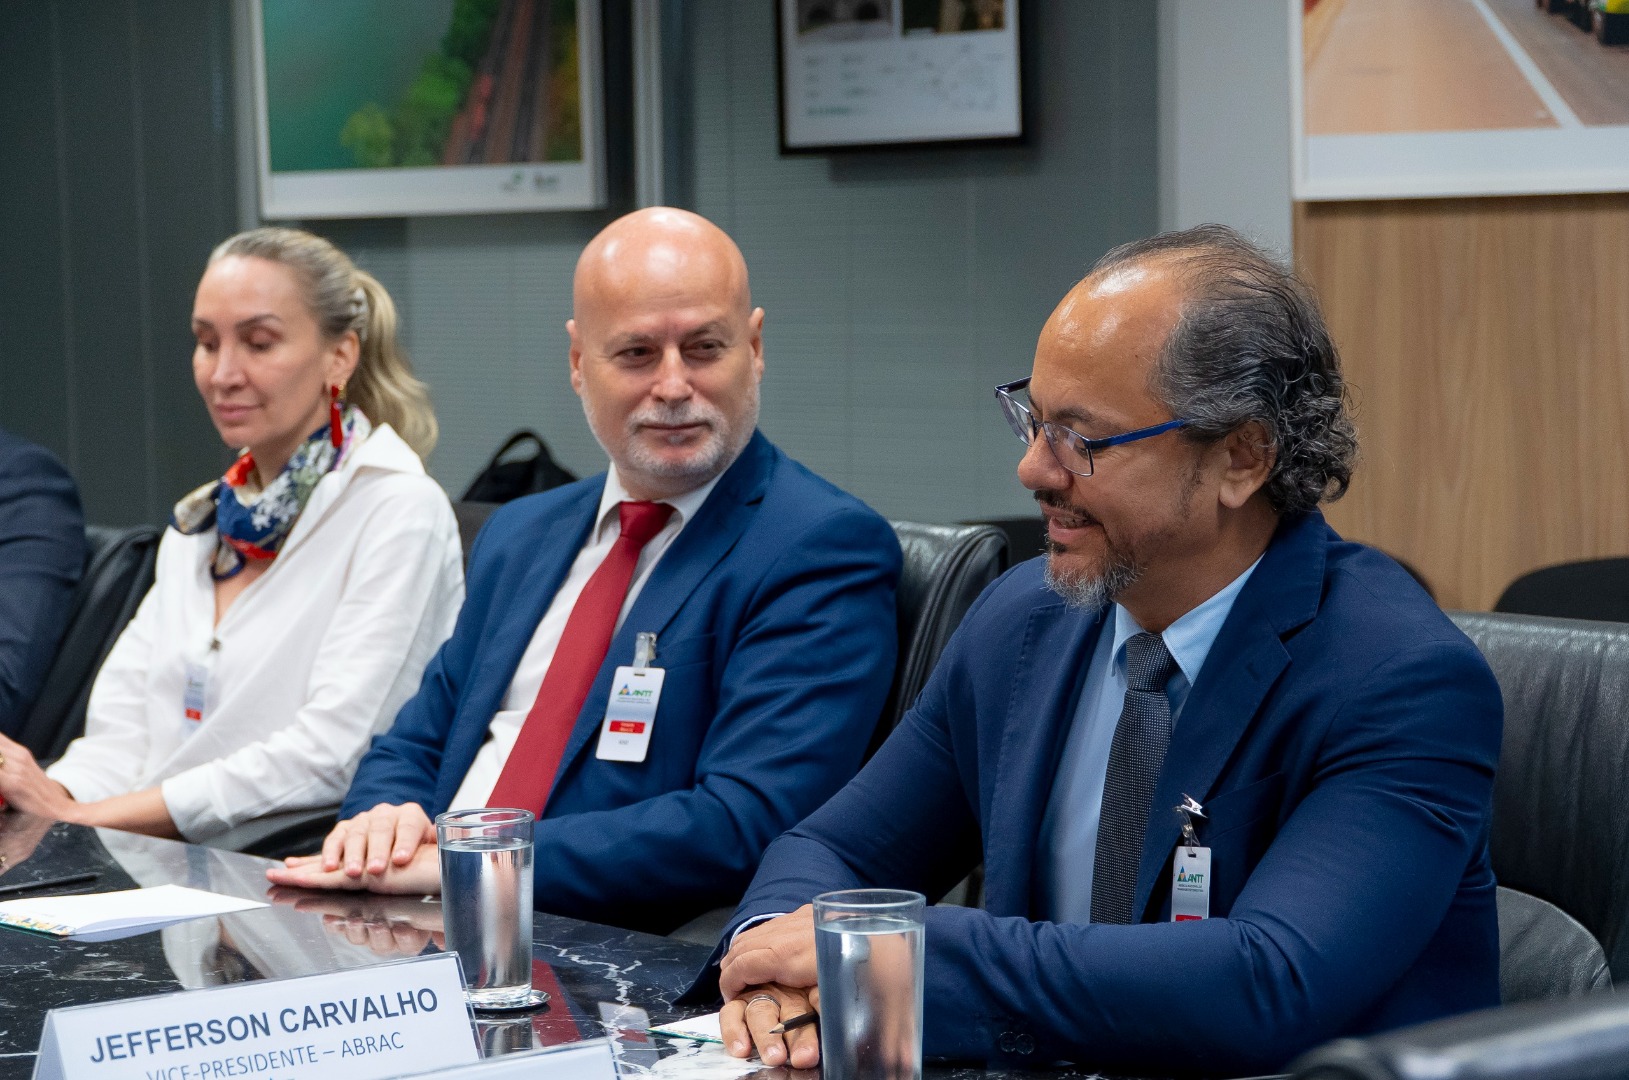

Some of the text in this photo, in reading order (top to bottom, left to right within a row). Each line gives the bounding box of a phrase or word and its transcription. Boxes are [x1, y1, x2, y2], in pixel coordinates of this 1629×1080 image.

[1187, 873, 1204, 883] ANTT
[89, 988, 438, 1063] JEFFERSON CARVALHO
[146, 1045, 319, 1080] VICE-PRESIDENTE
[341, 1031, 404, 1058] ABRAC
